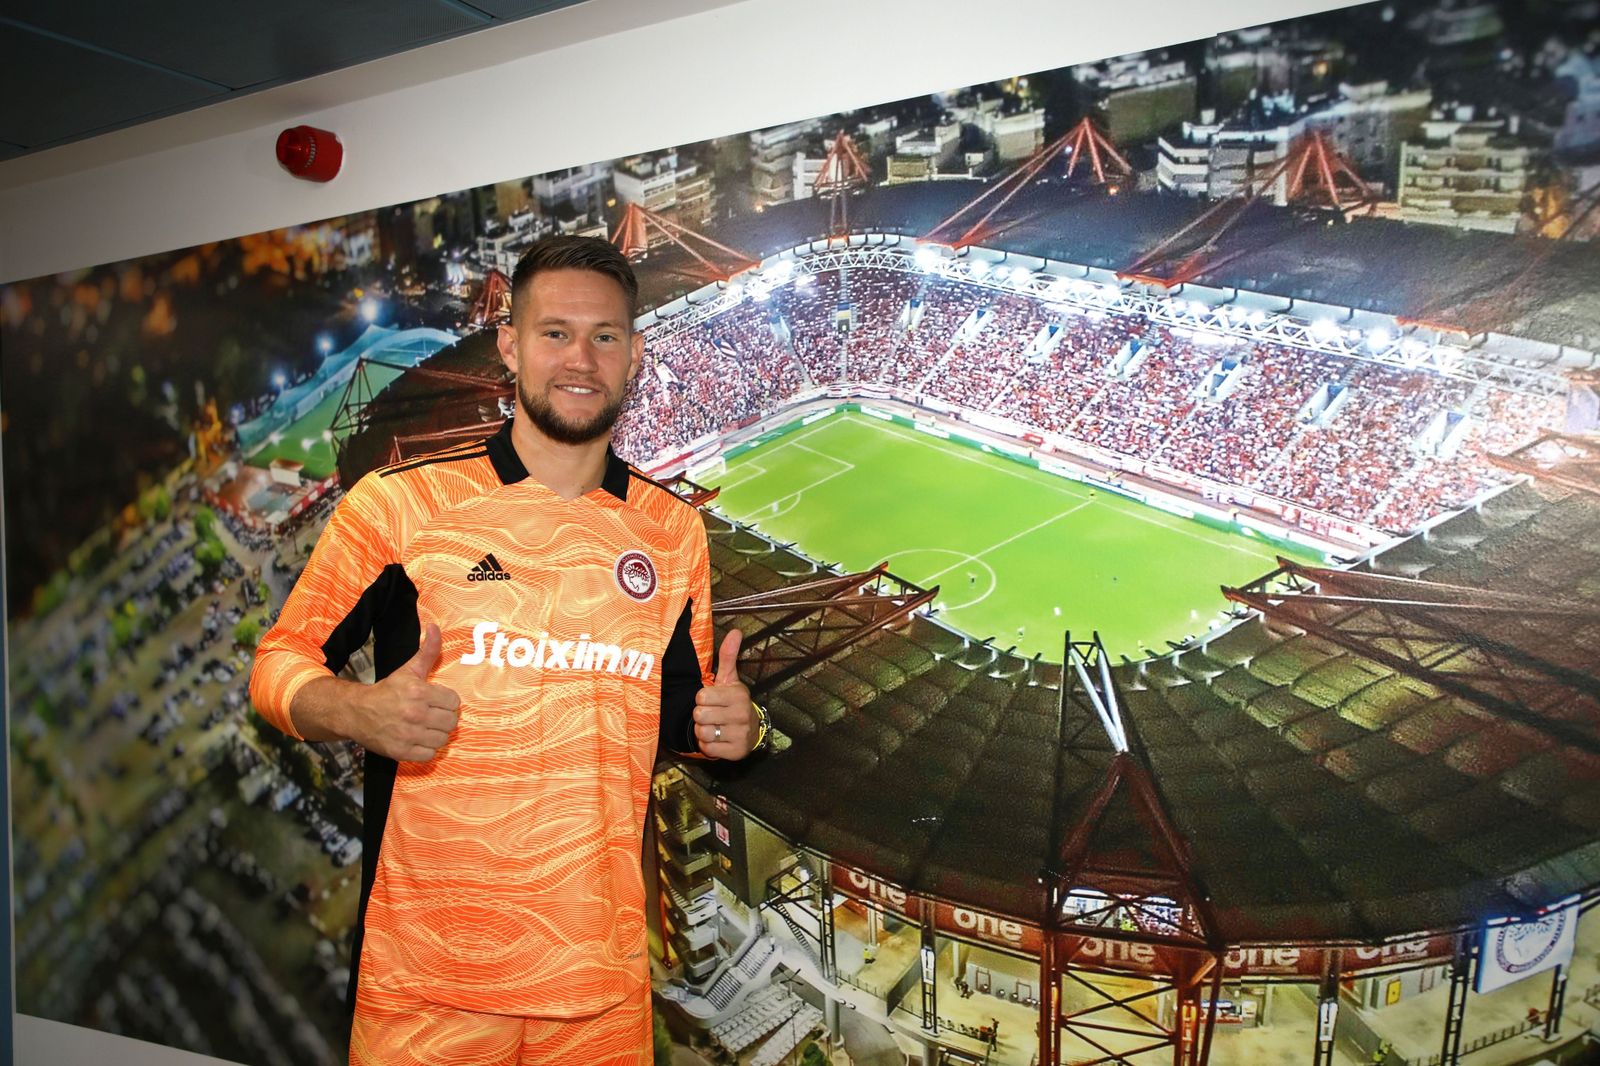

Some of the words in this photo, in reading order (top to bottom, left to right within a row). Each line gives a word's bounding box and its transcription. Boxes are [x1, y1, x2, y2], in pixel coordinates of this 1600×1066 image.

[467, 570, 511, 582] adidas
[460, 622, 654, 681] Stoiximan
[849, 867, 907, 906] one
[953, 907, 1023, 941] one
[1078, 936, 1156, 963] one
[1224, 943, 1300, 969] one
